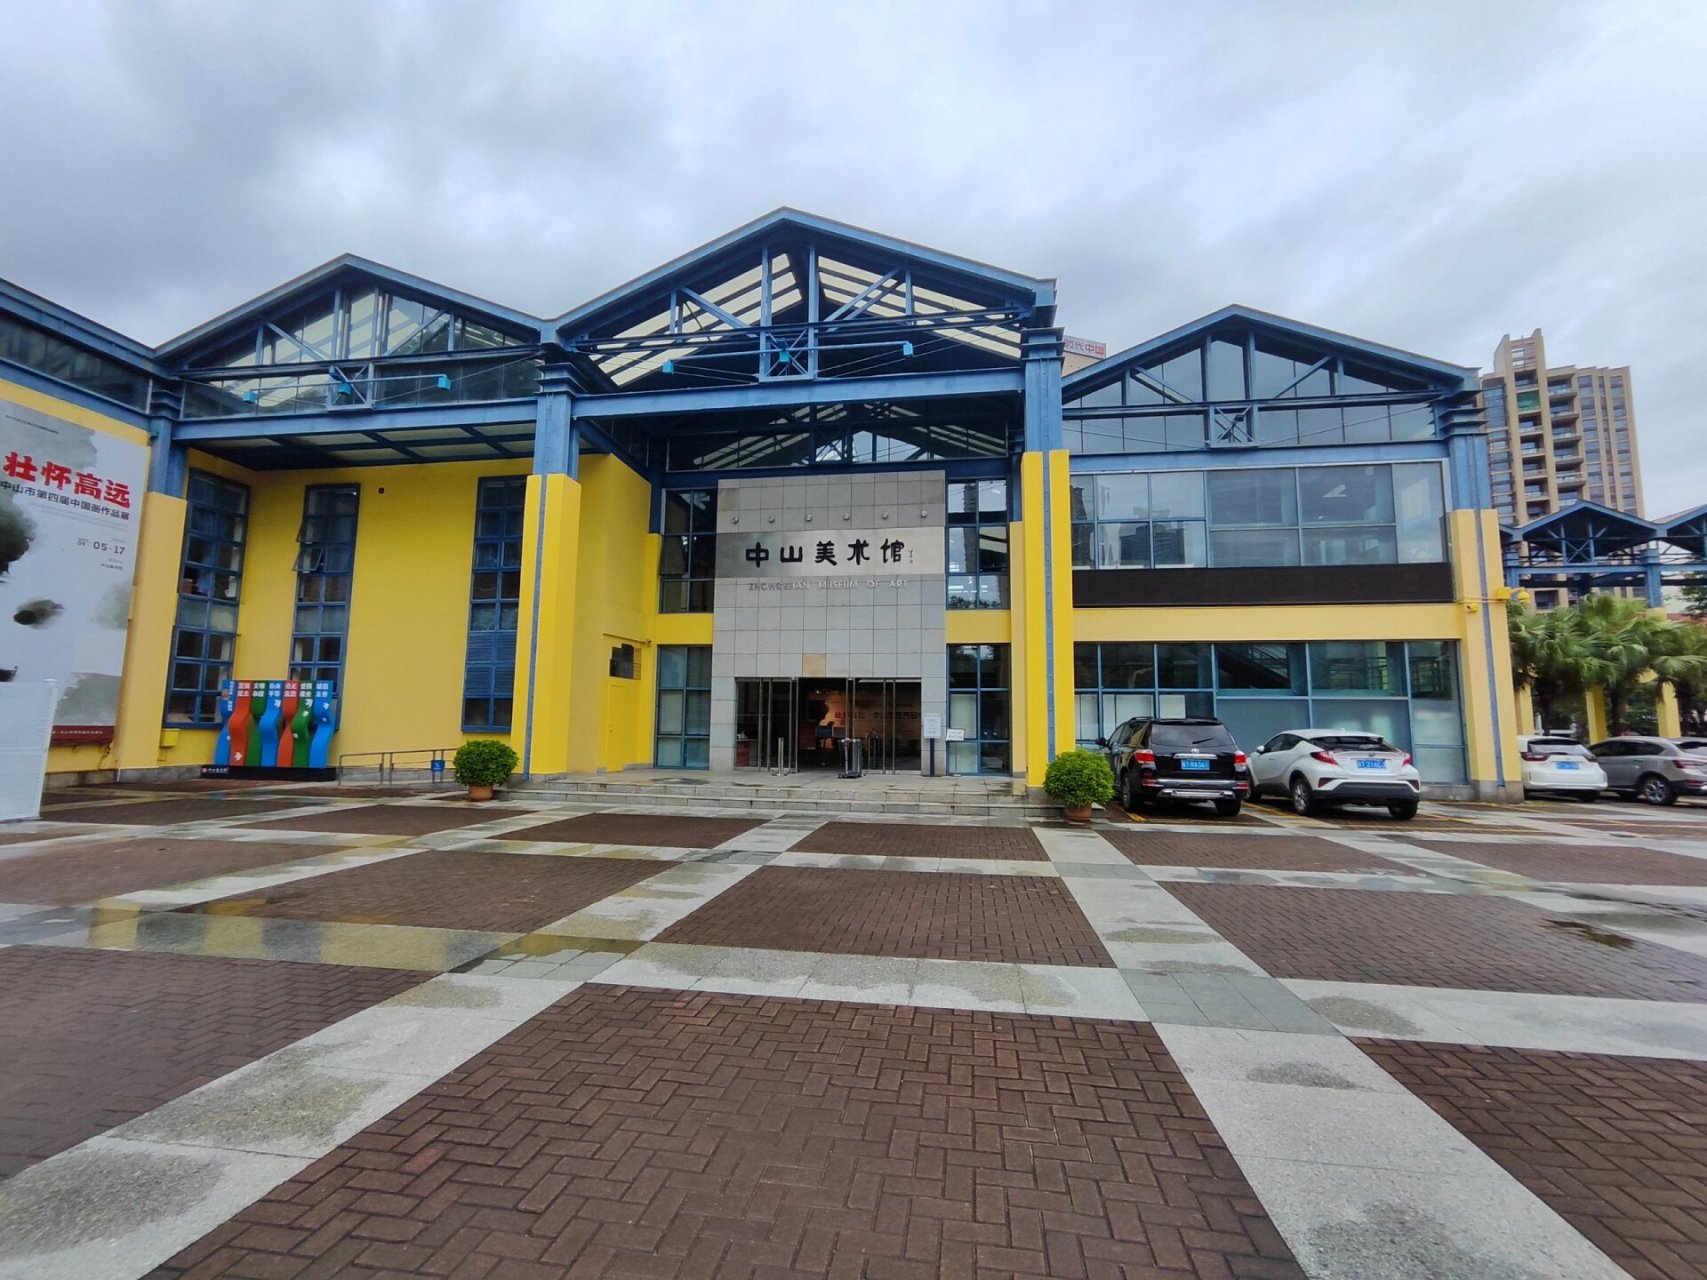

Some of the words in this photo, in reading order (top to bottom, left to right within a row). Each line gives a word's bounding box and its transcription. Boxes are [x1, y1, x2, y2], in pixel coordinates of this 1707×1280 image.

[3, 451, 130, 509] 壮怀高远
[0, 481, 130, 520] 中山市第四届中国画作品展
[745, 538, 905, 568] 中山美术馆
[818, 580, 858, 590] MUSEUM
[866, 580, 880, 589] OF
[889, 579, 907, 589] ART
